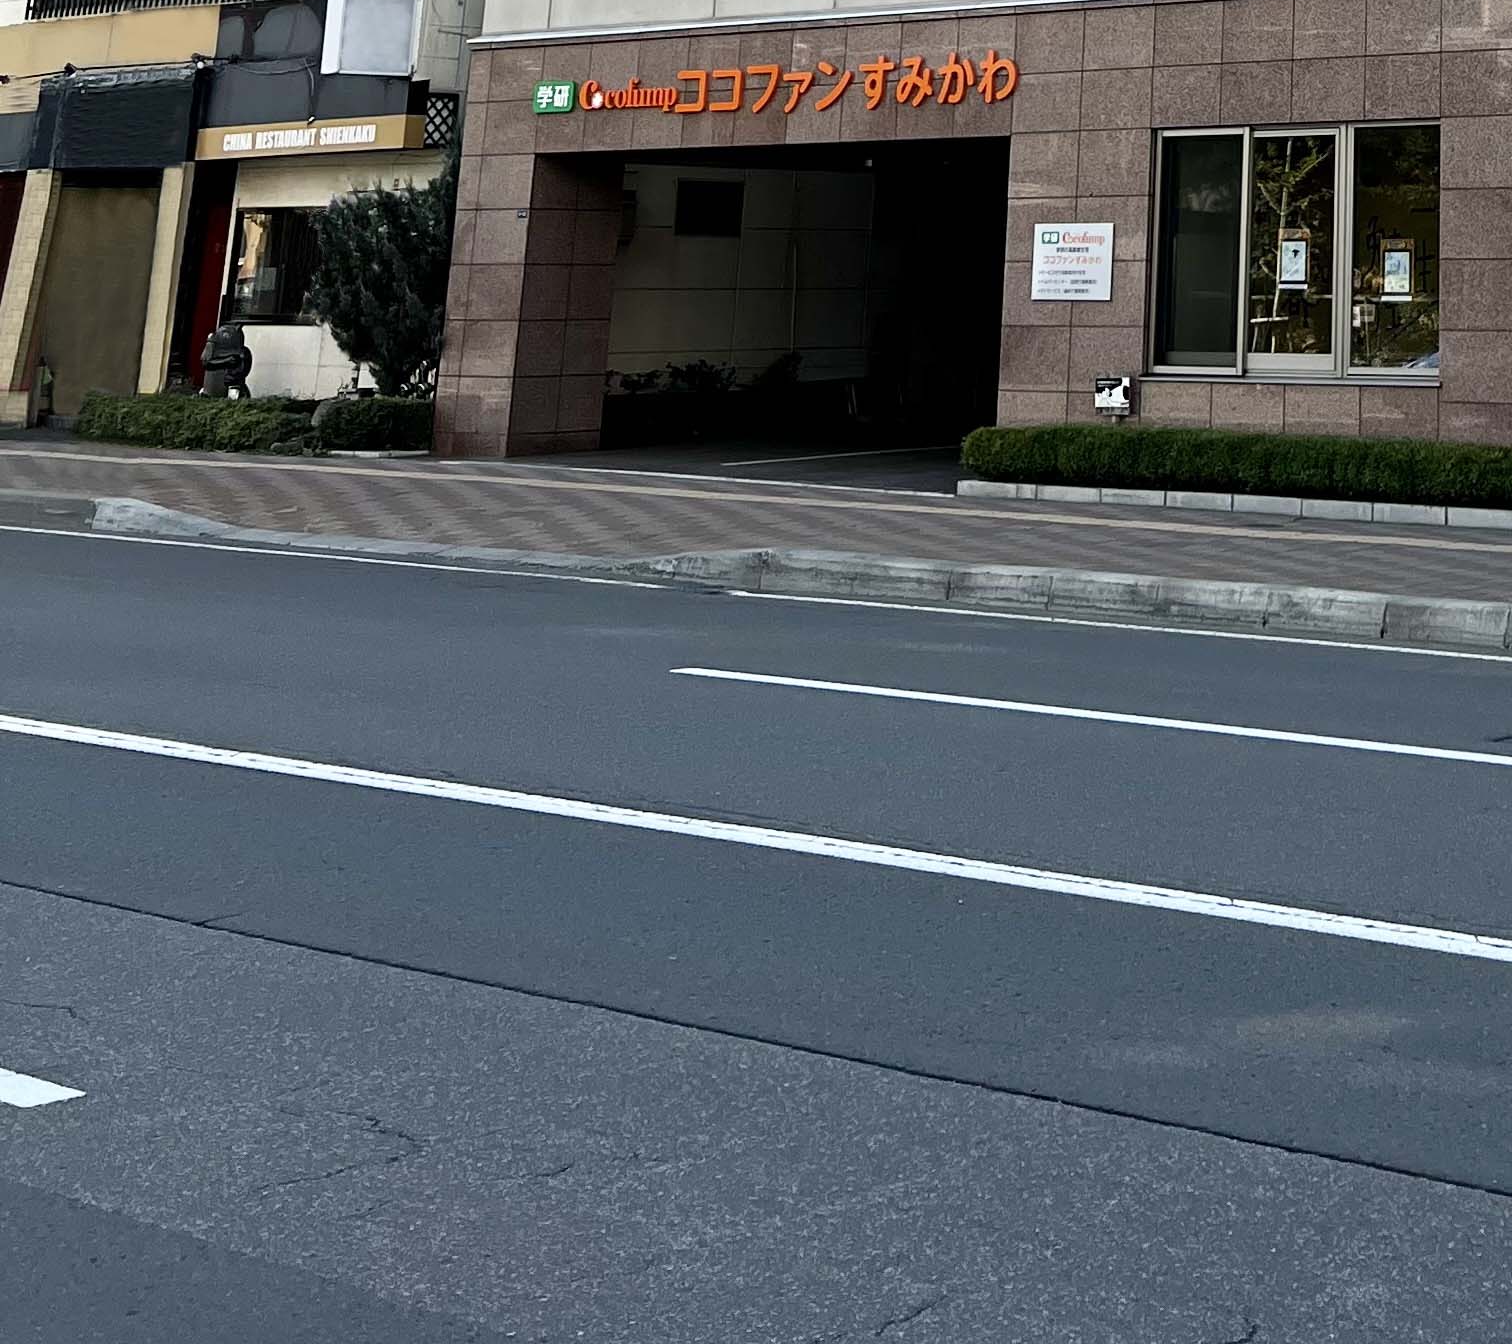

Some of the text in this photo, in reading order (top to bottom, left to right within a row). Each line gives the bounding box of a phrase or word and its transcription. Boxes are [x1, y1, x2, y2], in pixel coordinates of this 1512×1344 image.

[536, 49, 1019, 114] 学研 Cocofump ココファンすみかわ
[223, 132, 253, 152] CHINA
[255, 128, 318, 150] RESTAURANT
